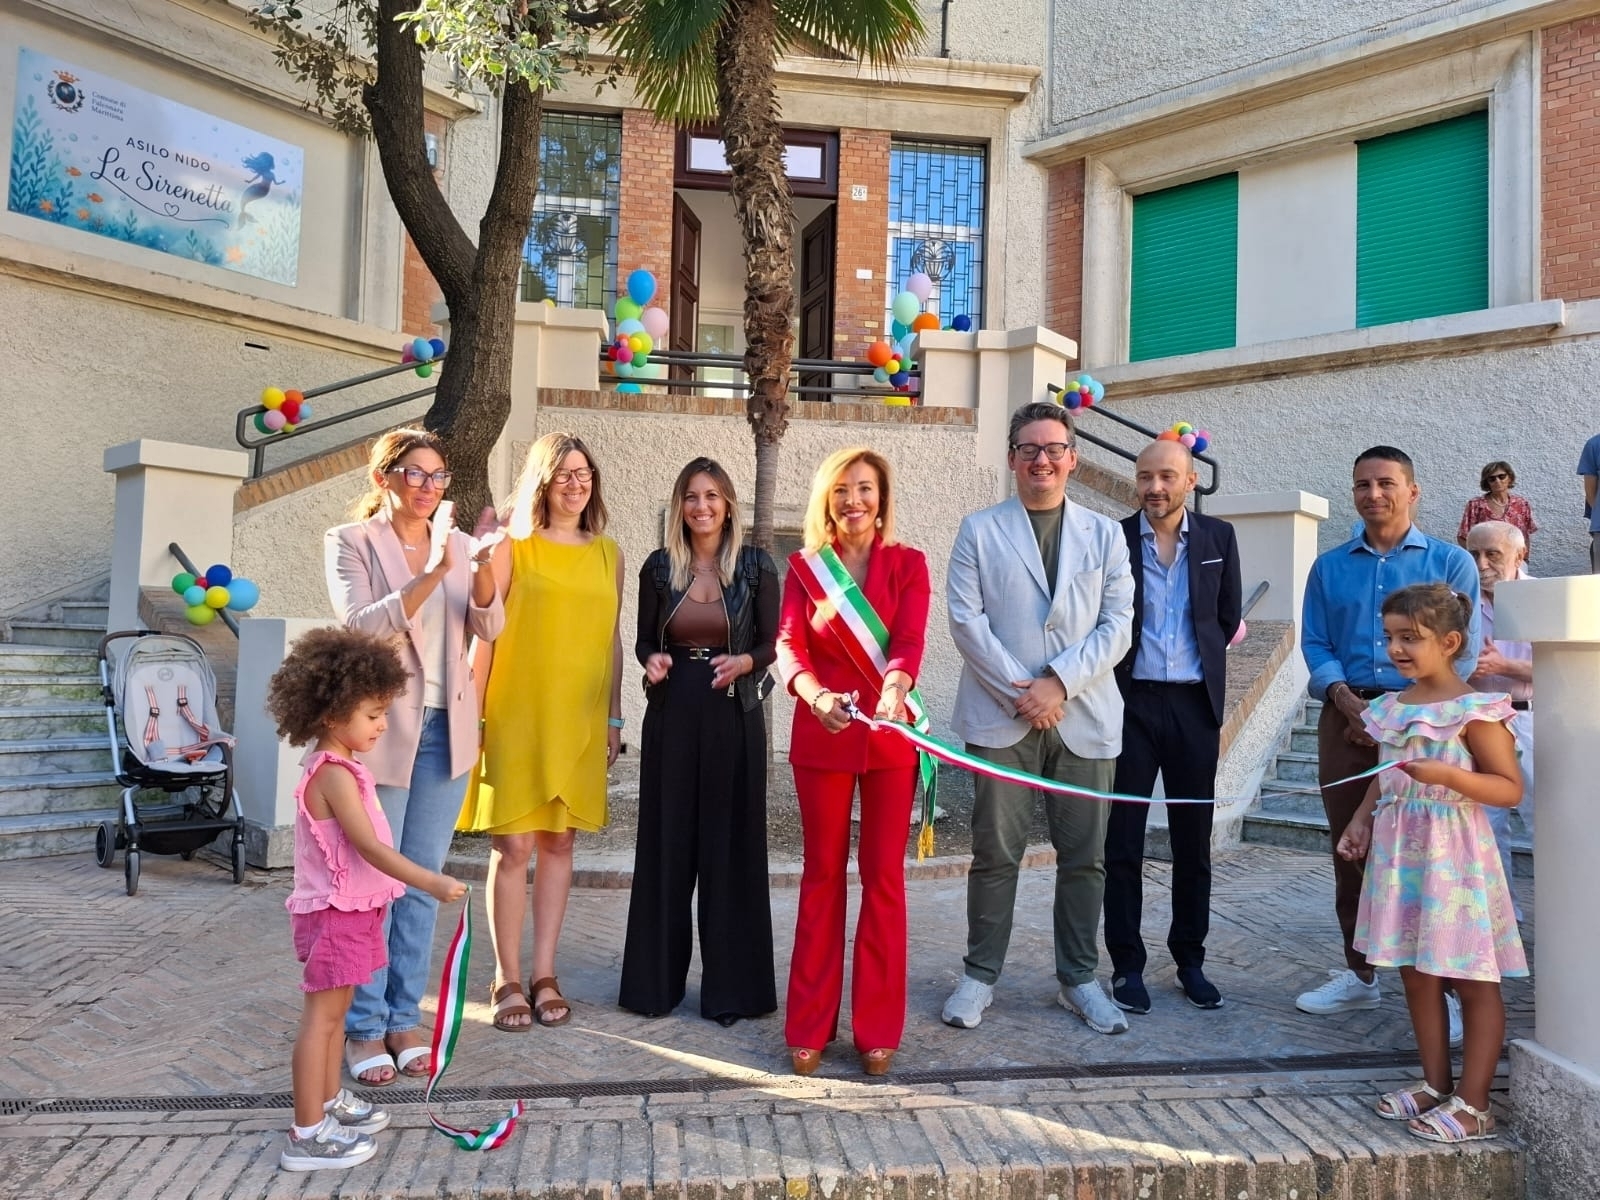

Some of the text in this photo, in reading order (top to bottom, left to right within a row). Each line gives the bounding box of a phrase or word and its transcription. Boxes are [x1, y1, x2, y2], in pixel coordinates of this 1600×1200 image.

[92, 91, 119, 105] Comune
[91, 105, 124, 121] Marittima
[125, 137, 210, 172] ASILO NIDO
[90, 147, 234, 213] La Sirenetta
